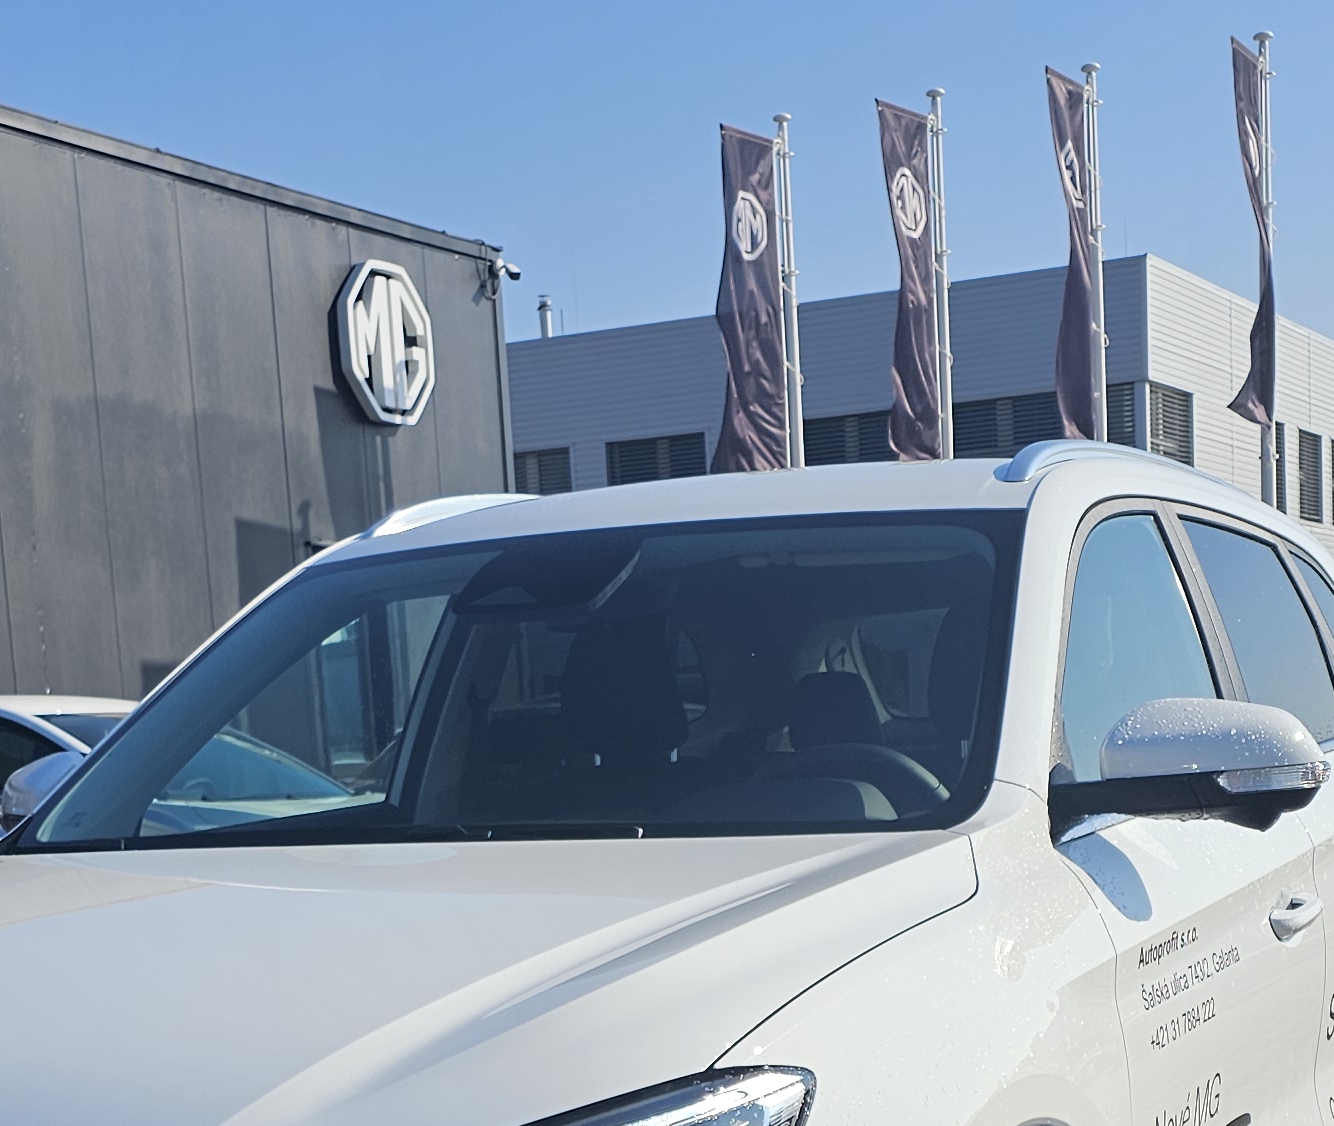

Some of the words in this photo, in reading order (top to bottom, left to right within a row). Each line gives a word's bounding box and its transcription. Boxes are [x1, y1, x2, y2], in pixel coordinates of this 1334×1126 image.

[354, 274, 427, 411] MG
[1138, 930, 1179, 970] Autoprofit
[1170, 972, 1190, 996] ulica
[1212, 945, 1240, 973] Galanta
[1150, 1023, 1169, 1050] +421
[1170, 1016, 1181, 1042] 31
[1182, 1005, 1201, 1035] 7884
[1202, 997, 1216, 1024] 222
